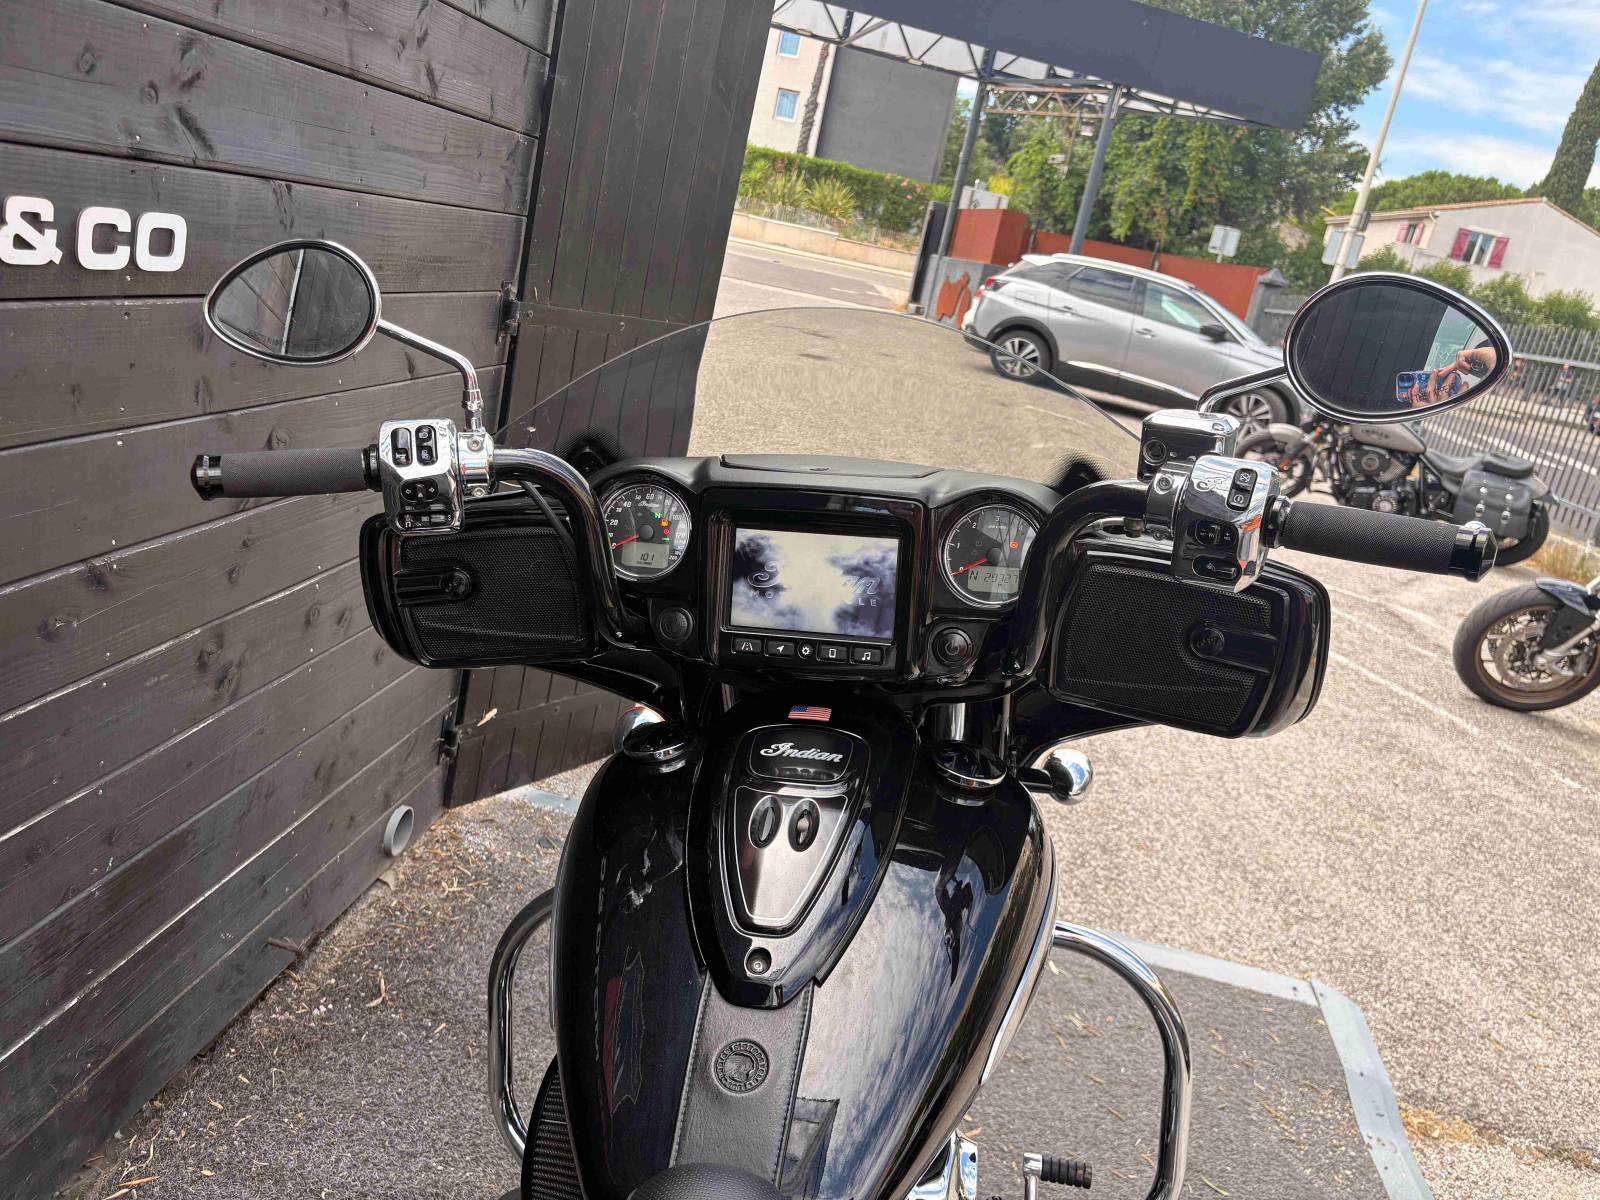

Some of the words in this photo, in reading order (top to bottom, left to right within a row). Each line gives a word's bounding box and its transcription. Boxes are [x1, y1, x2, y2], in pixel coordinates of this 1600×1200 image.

[640, 553, 655, 561] 101
[970, 570, 979, 580] N
[760, 743, 843, 762] Indian
